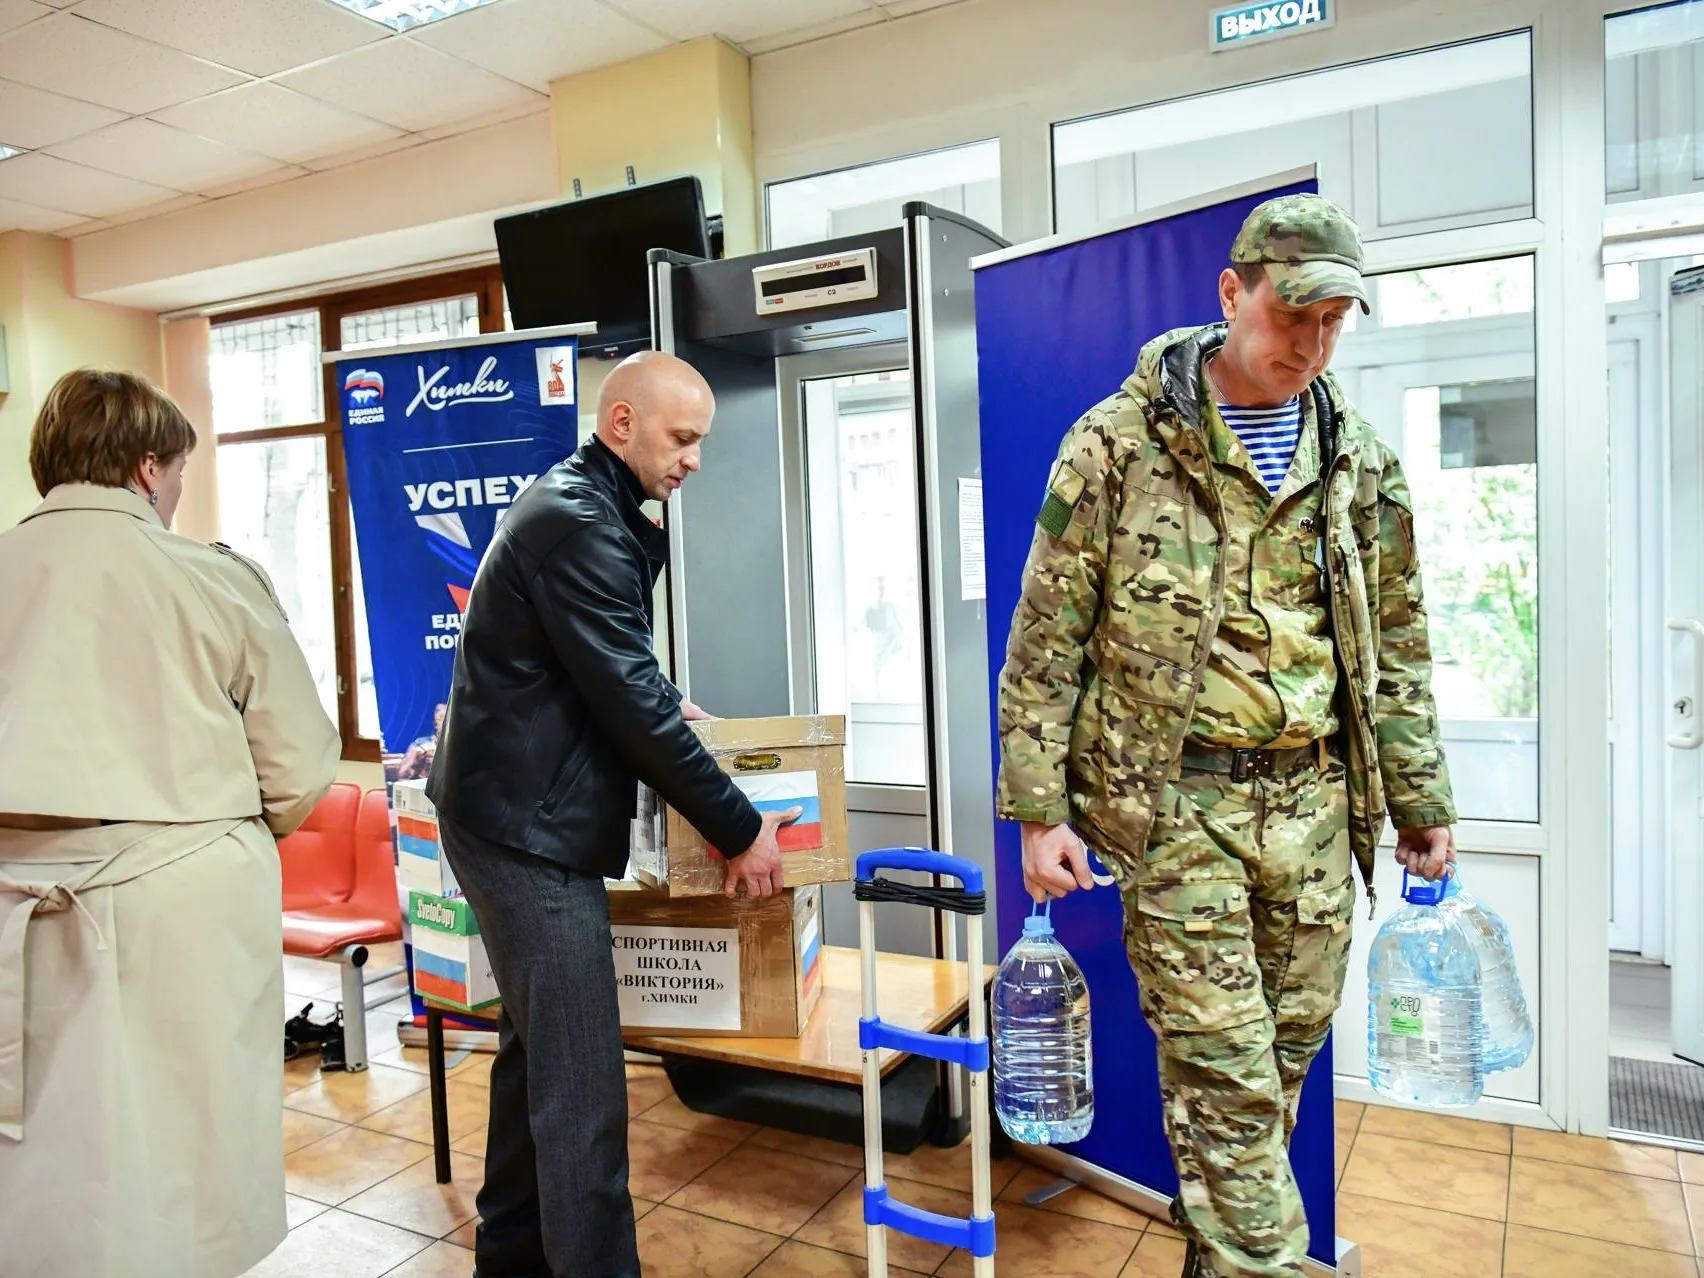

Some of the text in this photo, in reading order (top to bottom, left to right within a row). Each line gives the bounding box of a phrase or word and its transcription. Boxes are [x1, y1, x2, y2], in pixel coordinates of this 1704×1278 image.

[1221, 0, 1321, 38] ВЫХОД
[405, 356, 514, 417] Химки
[348, 406, 385, 417] ЕДИНАЯ
[349, 414, 385, 425] РОССИЯ
[404, 474, 538, 511] УСПЕХ
[417, 898, 455, 929] SvetoCopy
[612, 936, 727, 953] СПОРТИВНАЯ
[637, 956, 702, 971] ШКОЛА
[615, 974, 724, 991] «ВИКТОРИЯ»
[641, 993, 698, 1004] г.ХИМКИ
